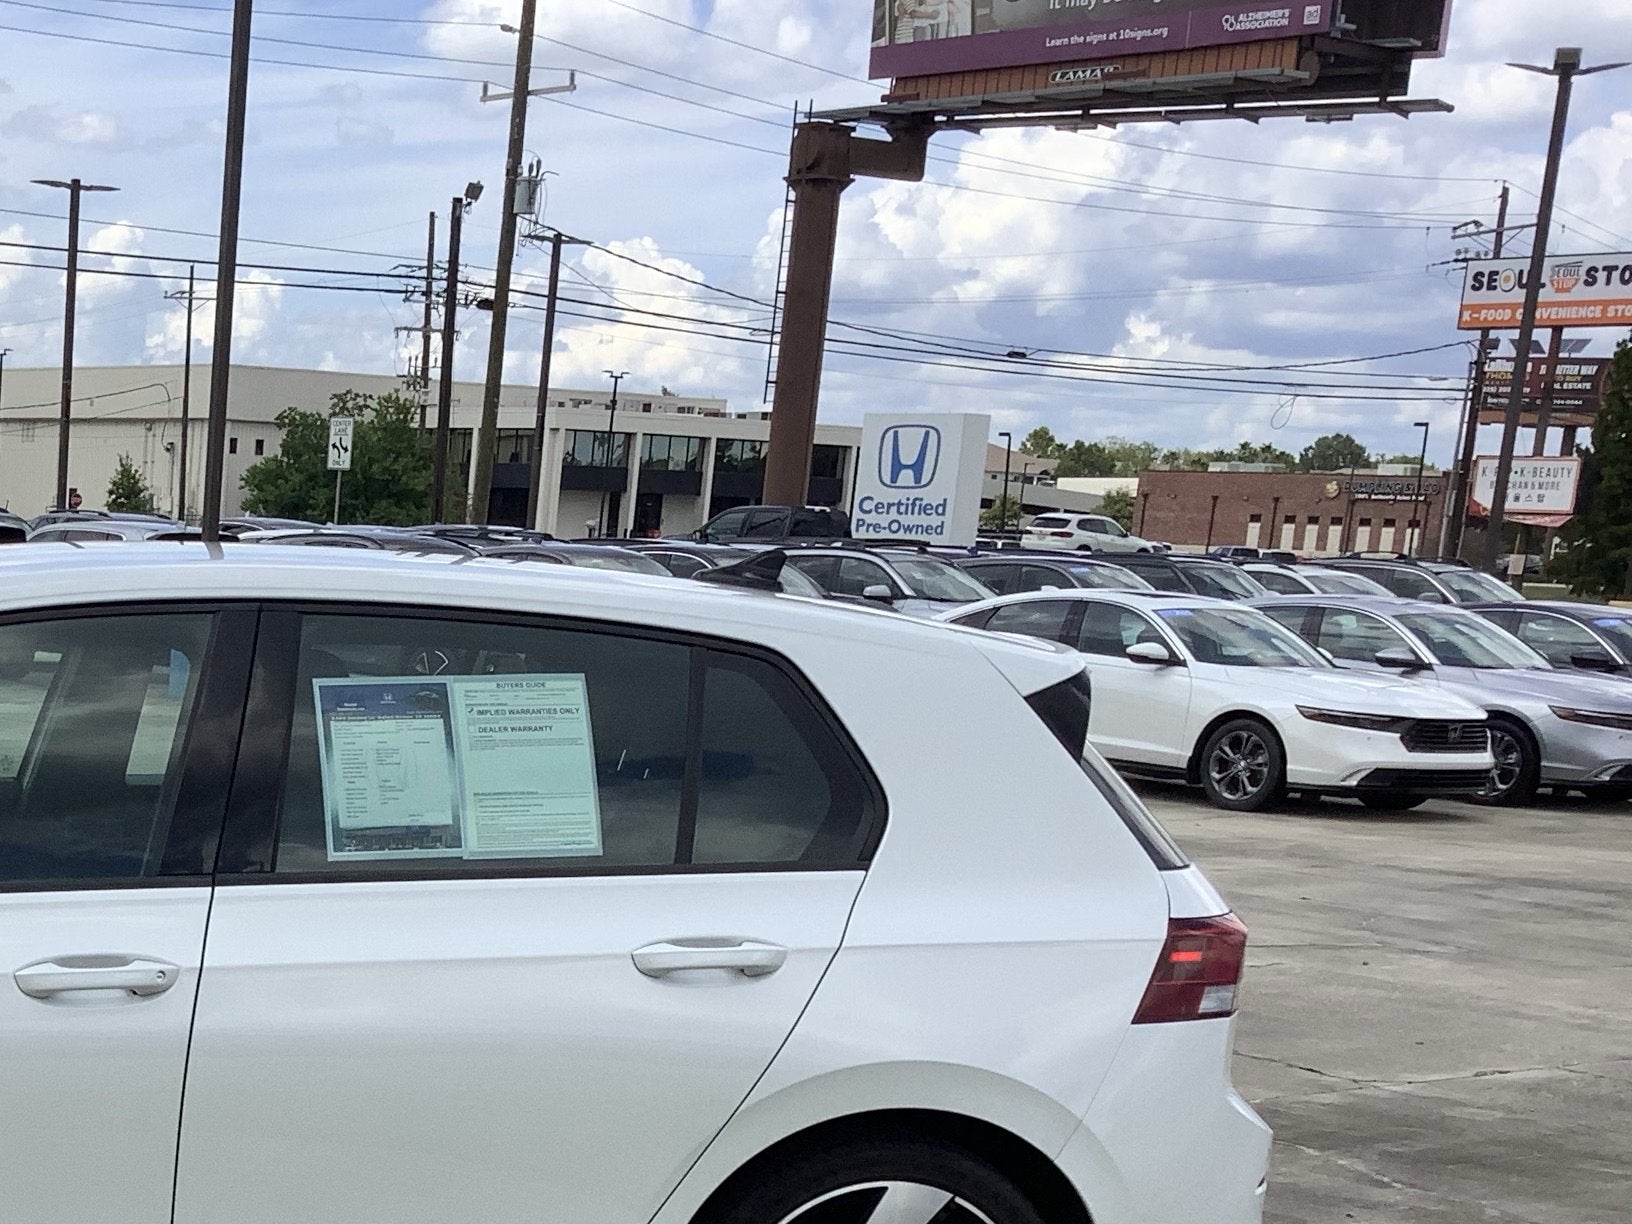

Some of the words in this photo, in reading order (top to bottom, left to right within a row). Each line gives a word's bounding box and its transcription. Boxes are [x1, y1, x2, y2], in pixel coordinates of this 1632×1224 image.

[1235, 18, 1289, 30] ASSOCIATION
[1045, 37, 1069, 47] Learn
[1070, 35, 1084, 44] the
[1086, 32, 1107, 45] signs
[1108, 32, 1117, 40] at
[1119, 26, 1168, 41] 10signs.org
[1462, 308, 1512, 322] K-FOOD
[1516, 305, 1602, 321] CNVENIENCE
[858, 496, 948, 517] Certified
[855, 518, 945, 536] Pre-Owned
[507, 707, 558, 716] WARRANTIES
[559, 707, 581, 715] ONLY
[510, 725, 553, 733] WARRANTY
